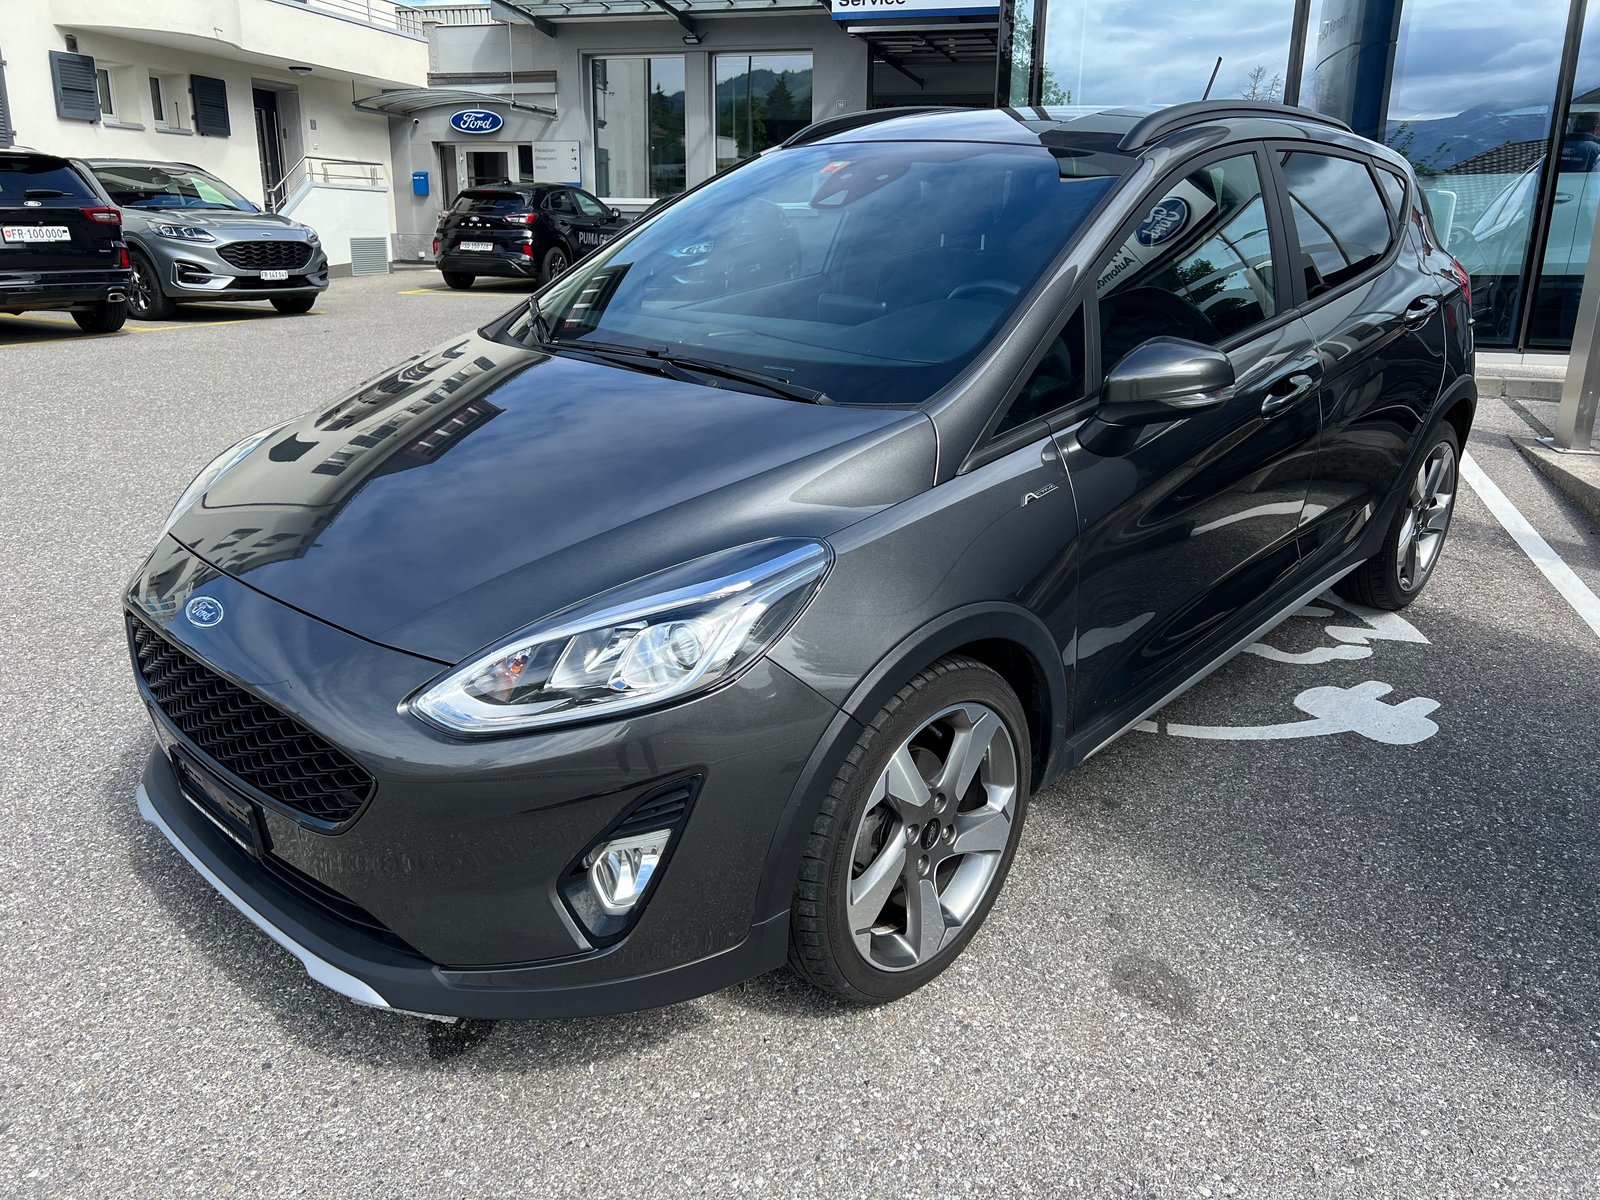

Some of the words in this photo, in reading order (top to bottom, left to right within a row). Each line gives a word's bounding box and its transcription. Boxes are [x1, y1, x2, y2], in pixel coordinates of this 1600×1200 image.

[460, 112, 493, 129] Ford
[578, 231, 598, 246] PUMA
[191, 601, 216, 621] Ford
